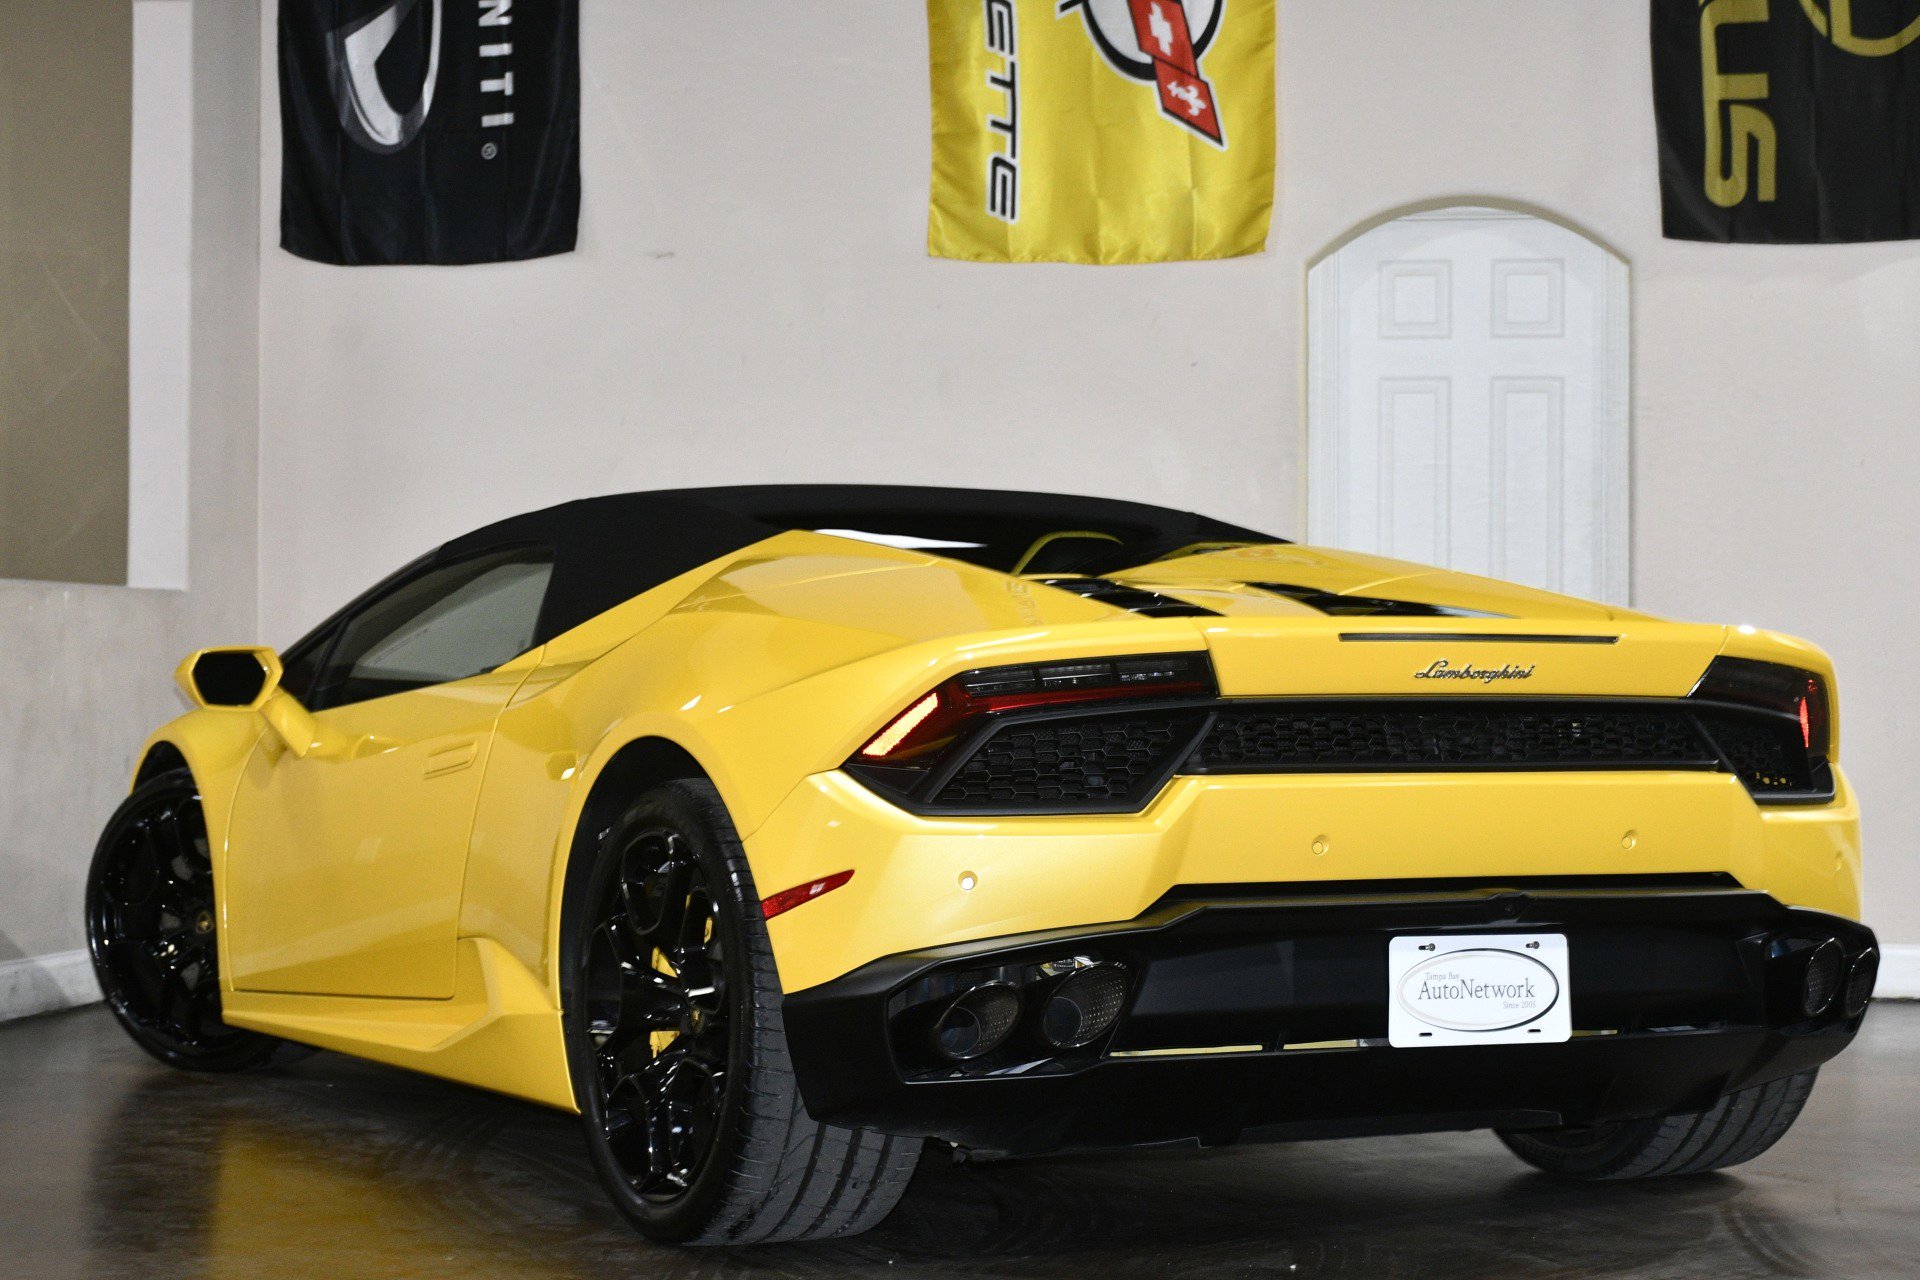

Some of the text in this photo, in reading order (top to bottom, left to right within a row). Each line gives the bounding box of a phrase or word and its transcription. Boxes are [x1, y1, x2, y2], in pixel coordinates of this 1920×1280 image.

[984, 0, 1018, 221] ETTE
[1414, 658, 1536, 684] Lamborghini
[1418, 977, 1536, 1001] AutoNetwork
[1425, 972, 1460, 982] Tampa Bay
[1502, 1001, 1519, 1010] Since
